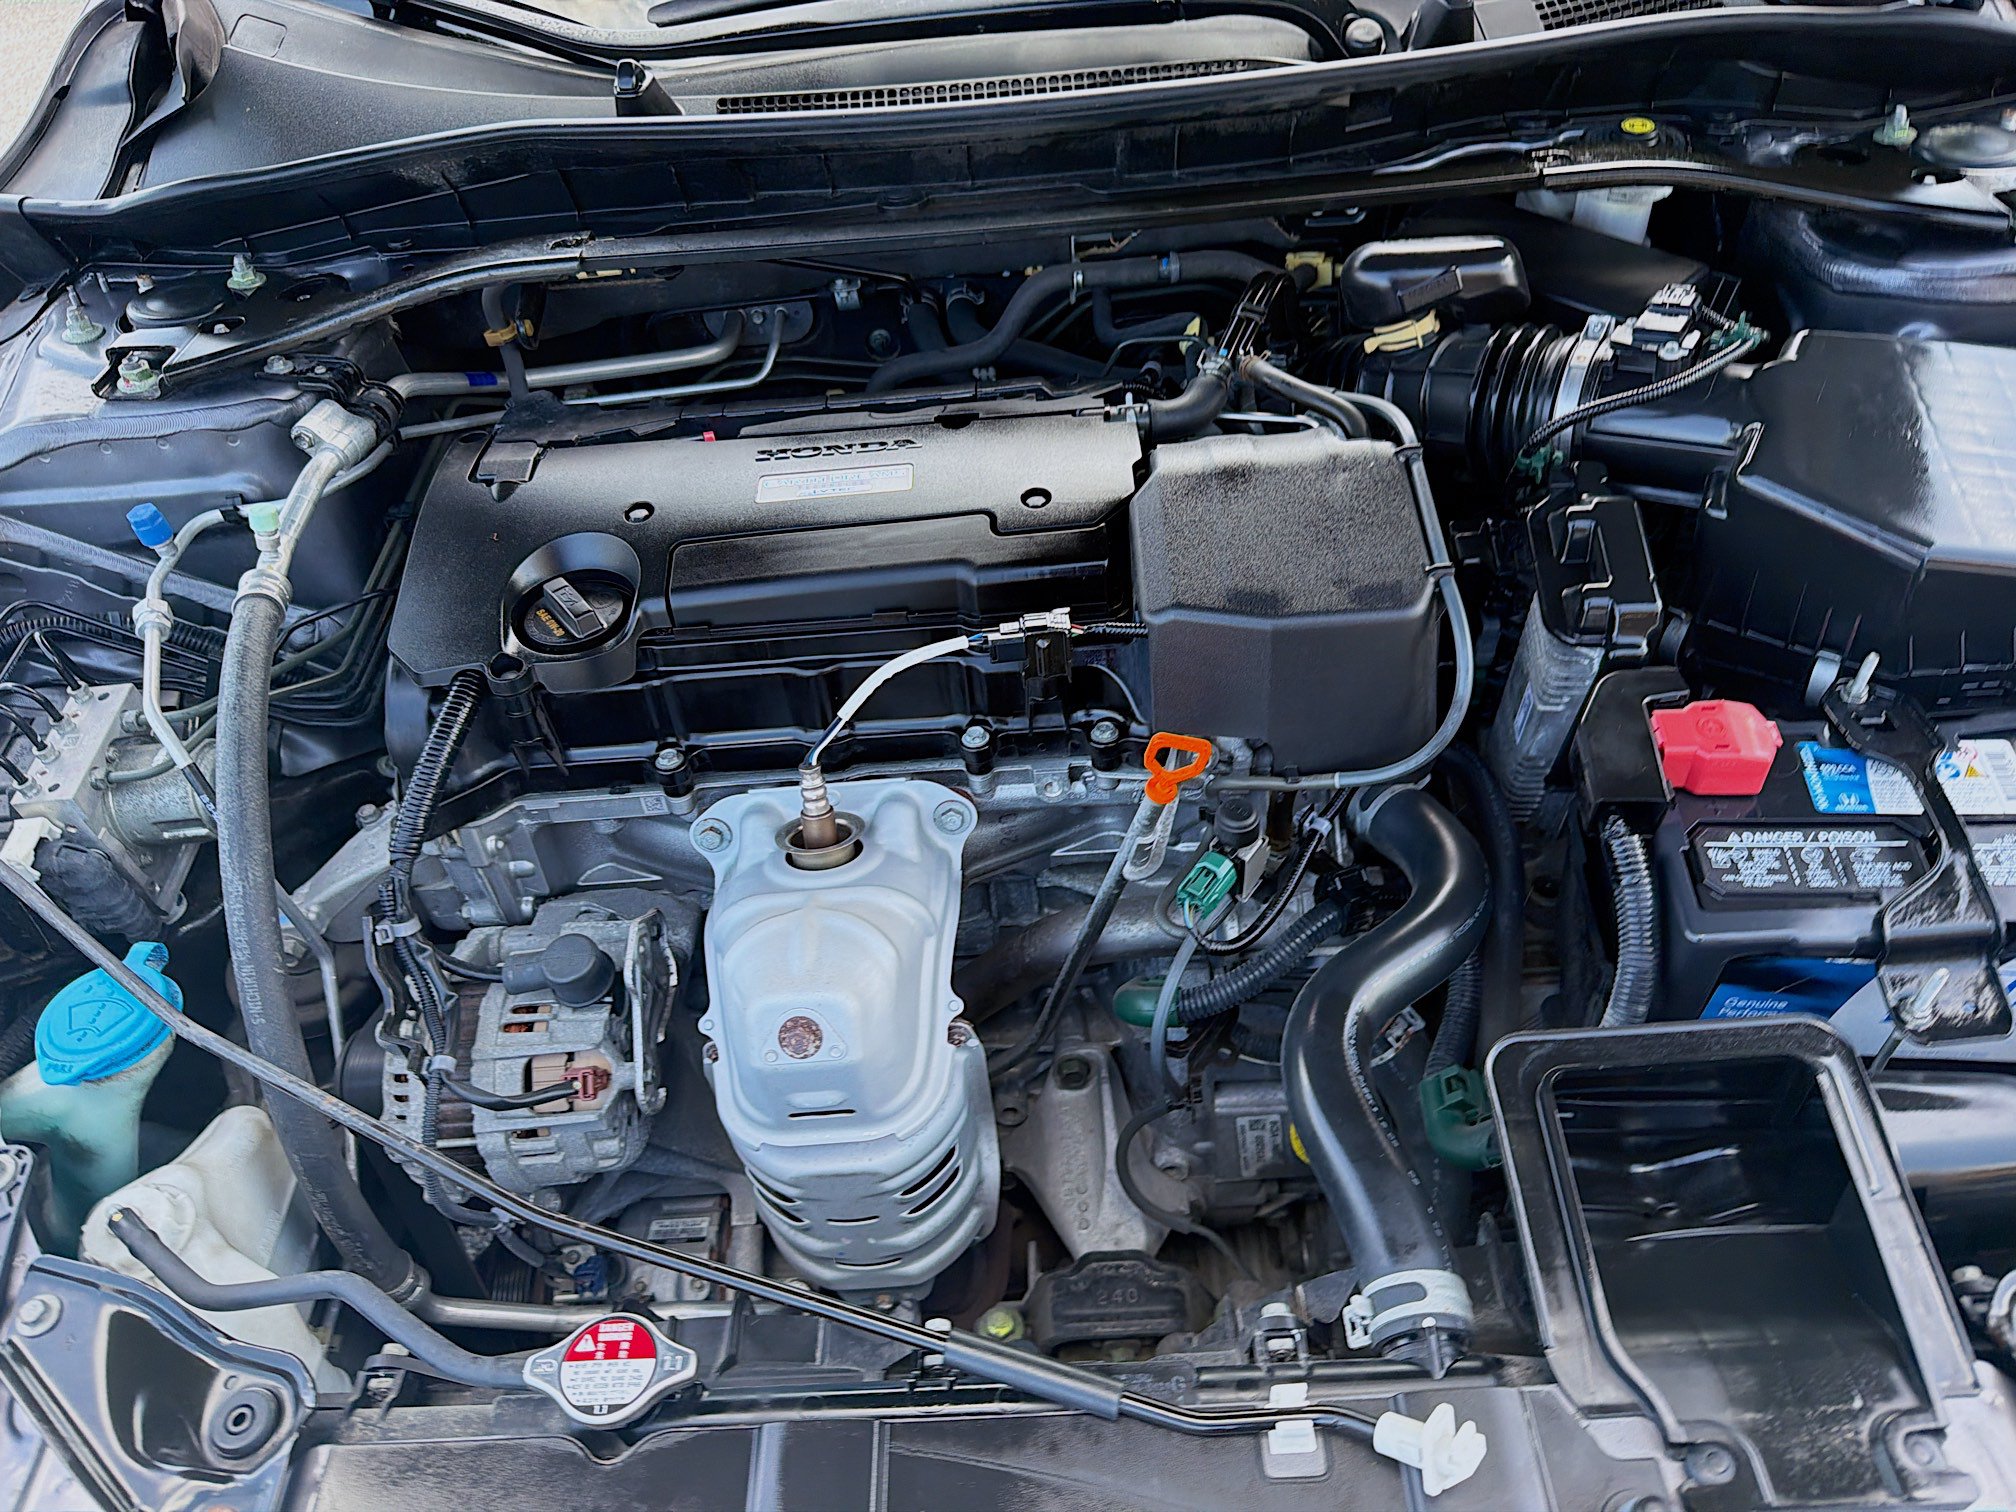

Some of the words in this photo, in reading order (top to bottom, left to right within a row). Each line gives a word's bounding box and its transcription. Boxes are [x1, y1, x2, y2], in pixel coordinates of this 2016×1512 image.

[755, 439, 922, 462] HONDA
[1740, 831, 1804, 844] DANGER
[1818, 830, 1877, 844] POISON
[1724, 996, 1788, 1009] Genuine
